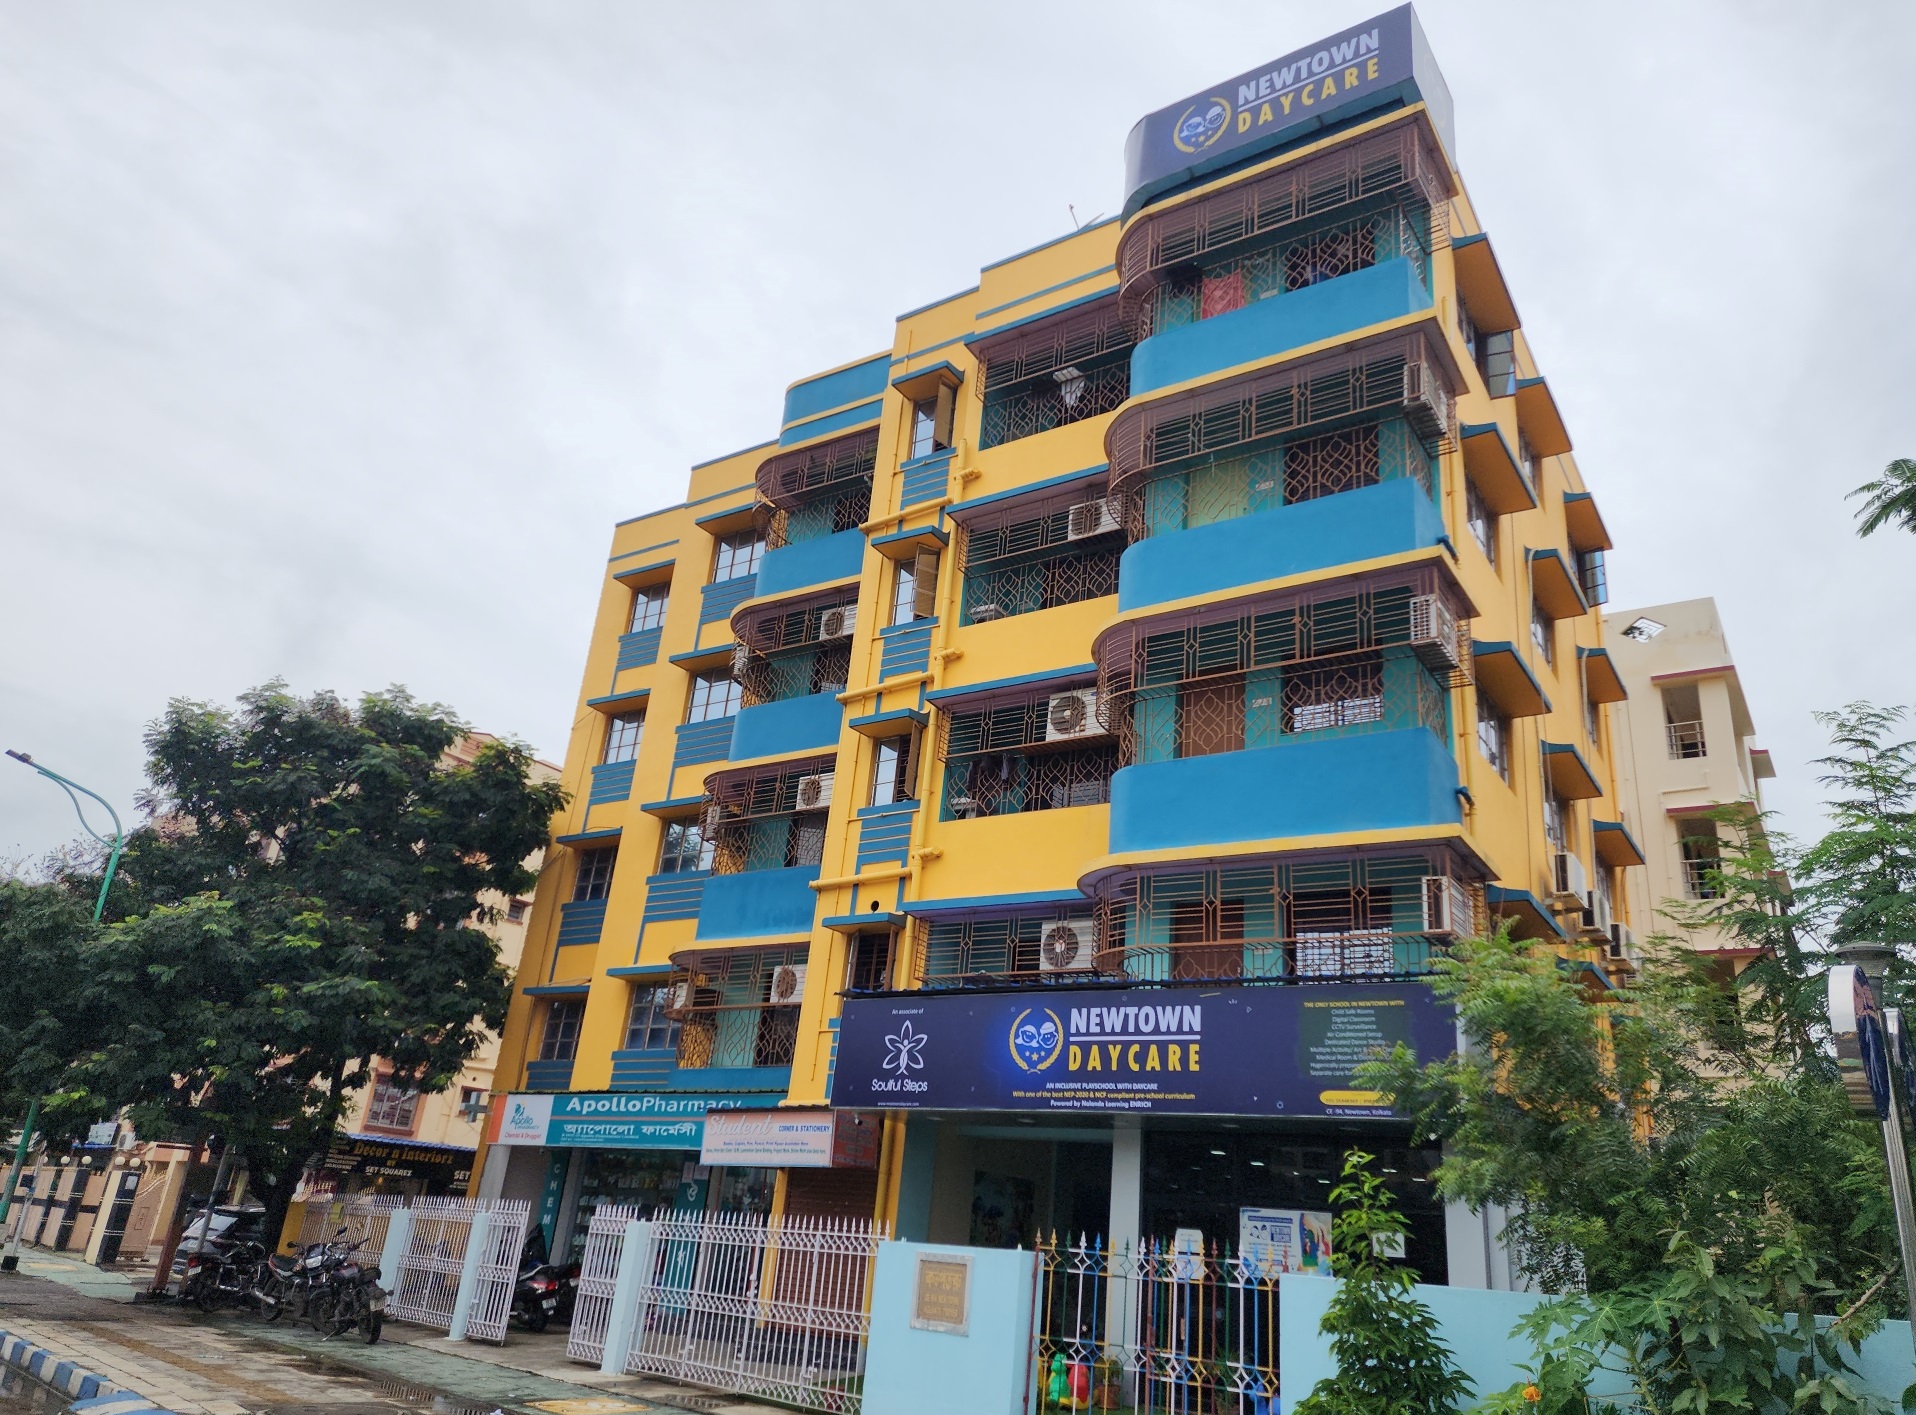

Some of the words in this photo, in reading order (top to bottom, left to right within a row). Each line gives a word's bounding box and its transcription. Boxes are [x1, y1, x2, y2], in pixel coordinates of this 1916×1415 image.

[1238, 28, 1379, 107] NEWTOWN
[1238, 57, 1379, 134] DAYCARE
[1070, 1005, 1202, 1034] NEWTOWN
[1068, 1043, 1200, 1072] DAYCARE
[871, 1078, 901, 1092] Soulful
[902, 1078, 928, 1094] Steps
[1046, 1082, 1054, 1090] AN
[1055, 1082, 1082, 1090] INCLUSIVE
[1082, 1082, 1116, 1090] PLAYSCHOOL
[1074, 1100, 1080, 1108] by
[1106, 1100, 1128, 1108] Learning
[1108, 1092, 1134, 1100] compliant
[1135, 1092, 1164, 1100] pre-school
[566, 1097, 742, 1116] ApolloPharmacy
[510, 1114, 534, 1129] Apollo
[709, 1114, 772, 1136] Student
[778, 1124, 794, 1132] CORNER
[796, 1124, 799, 1132] &
[353, 1140, 390, 1157] Decor
[365, 1166, 379, 1174] SET
[380, 1166, 413, 1176] SQUAREZ
[454, 1170, 471, 1180] SET
